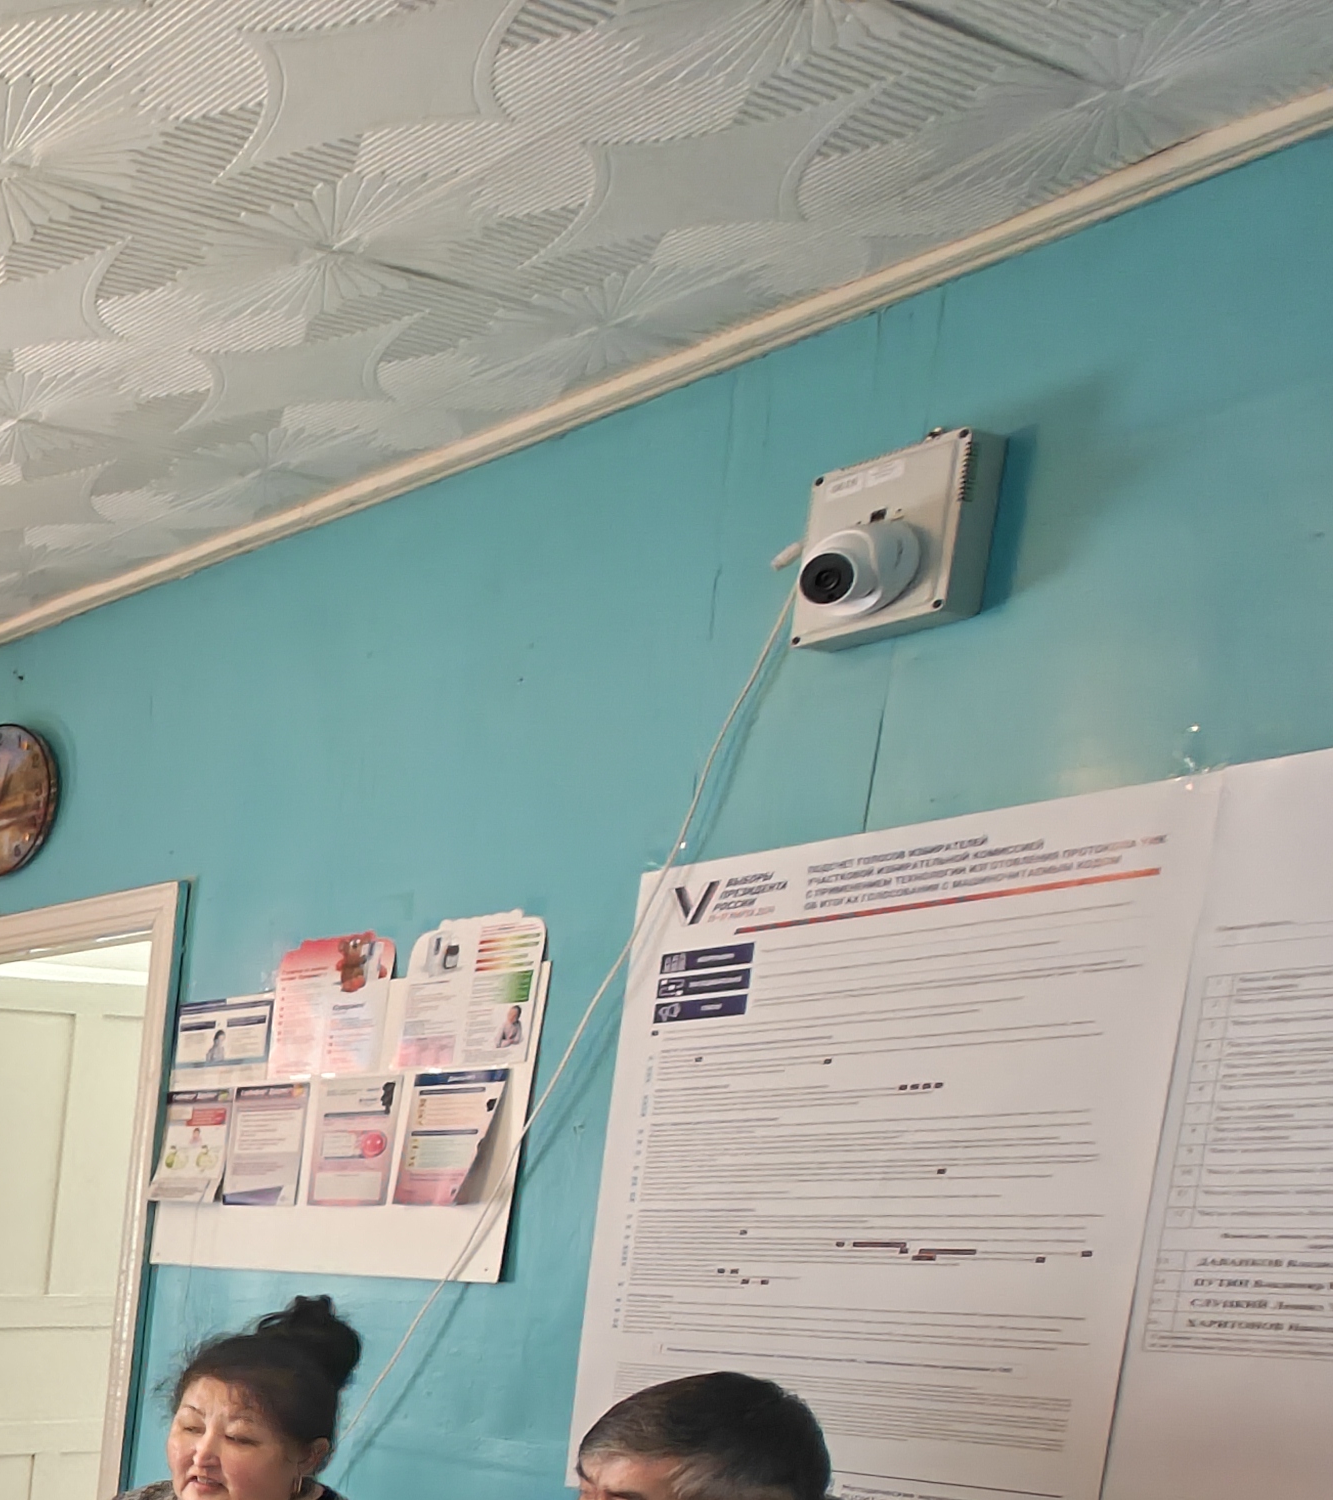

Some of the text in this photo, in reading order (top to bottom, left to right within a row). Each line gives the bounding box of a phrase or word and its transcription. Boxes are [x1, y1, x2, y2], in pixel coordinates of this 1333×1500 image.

[908, 835, 989, 858] ИЗБИРАТЕЛЕЙ
[807, 838, 1045, 886] УЧАСТКОВОЙ ИЗБИРАТЕЛЬНОЙ КОМИССИЕЙ
[725, 871, 775, 888] ВЫБОРЫ
[718, 880, 788, 900] ПРЕЗИДЕНТА
[712, 898, 757, 912] РОССИИ
